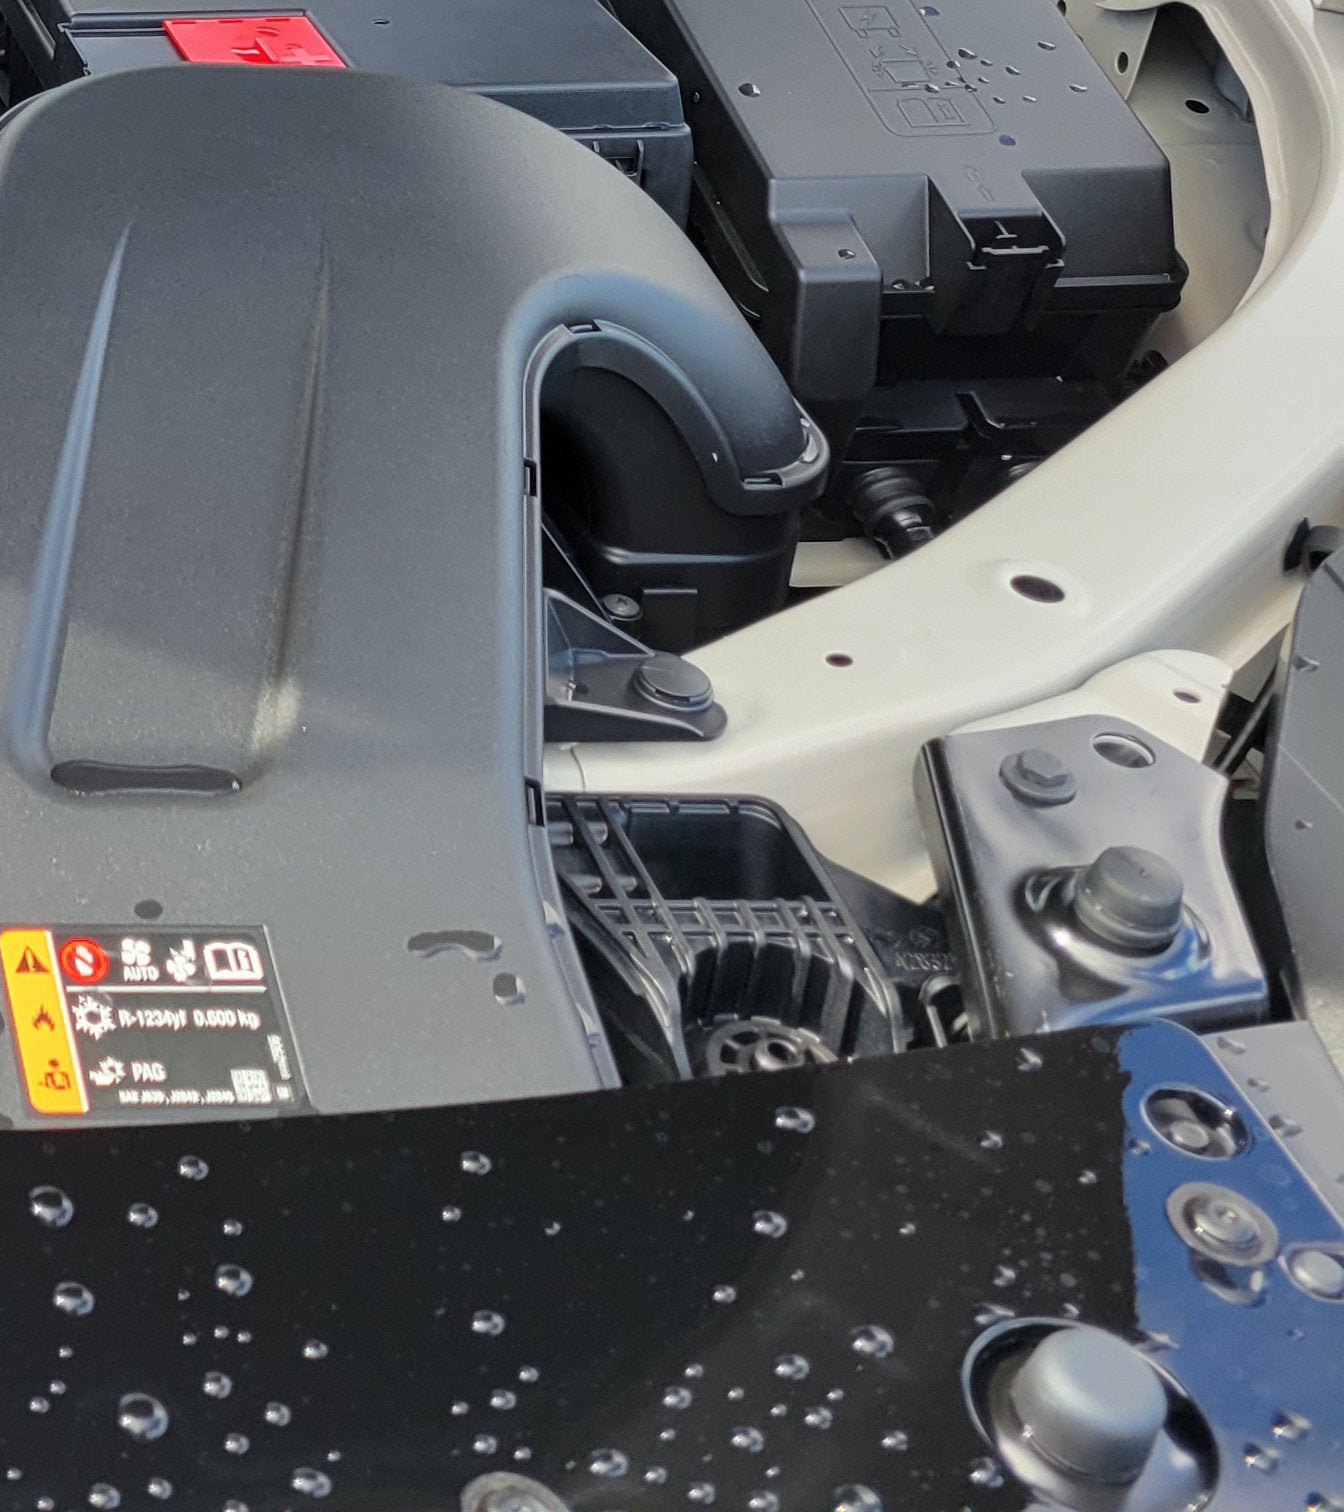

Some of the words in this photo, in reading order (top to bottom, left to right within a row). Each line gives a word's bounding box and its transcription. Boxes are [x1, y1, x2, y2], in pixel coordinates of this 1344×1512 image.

[123, 965, 160, 982] AUTO
[118, 1008, 188, 1031] R-1234yf
[237, 1008, 261, 1031] kg
[131, 1061, 168, 1083] PAG
